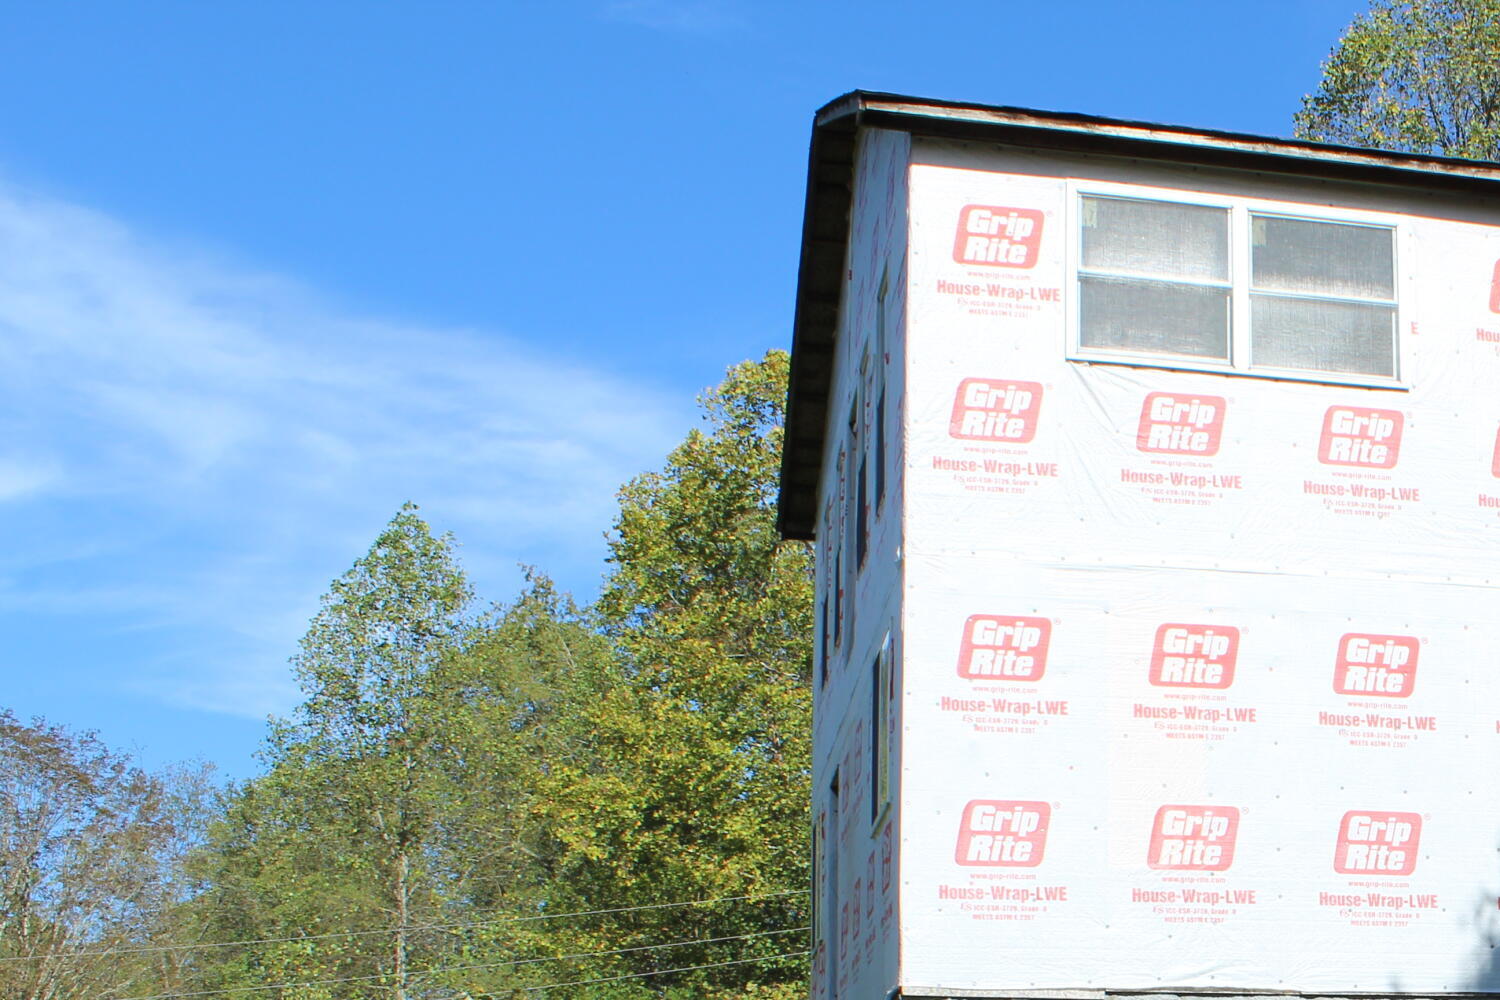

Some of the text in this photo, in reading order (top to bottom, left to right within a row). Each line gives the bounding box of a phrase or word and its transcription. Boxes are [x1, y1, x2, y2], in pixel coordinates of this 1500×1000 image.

[966, 209, 1033, 241] Grip
[964, 236, 1027, 263] Rite
[937, 279, 1061, 302] House-Wrap-LWE
[964, 382, 1031, 415] Grip
[961, 410, 1025, 438] Rite
[1150, 397, 1215, 428] Grip
[1147, 423, 1209, 451] Rite
[1330, 411, 1394, 442] Grip
[1328, 437, 1388, 464] Rite
[933, 455, 1058, 477] House-Wrap-LWE
[1120, 467, 1242, 490] House-Wrap-LWE
[1303, 479, 1420, 501] House-Wrap-LWE
[971, 619, 1040, 652] Grip
[1162, 628, 1229, 660] Grip
[969, 648, 1034, 676] Rite
[1346, 638, 1409, 669] Grip
[1160, 656, 1223, 683] Rite
[1343, 665, 1404, 692] Rite
[940, 696, 1068, 716] House-Wrap-LWE
[1133, 703, 1257, 723] House-Wrap-LWE
[1318, 711, 1437, 731] House-Wrap-LWE
[969, 805, 1039, 837] Grip
[1161, 810, 1229, 841] Grip
[1347, 815, 1412, 847] Grip
[966, 834, 1032, 861] Rite
[1158, 839, 1222, 865] Rite
[1344, 844, 1405, 870] Rite
[938, 884, 1067, 903] House-Wrap-LWE
[1131, 887, 1256, 906] House-Wrap-LWE
[1318, 891, 1439, 910] House-Wrap-LWE
